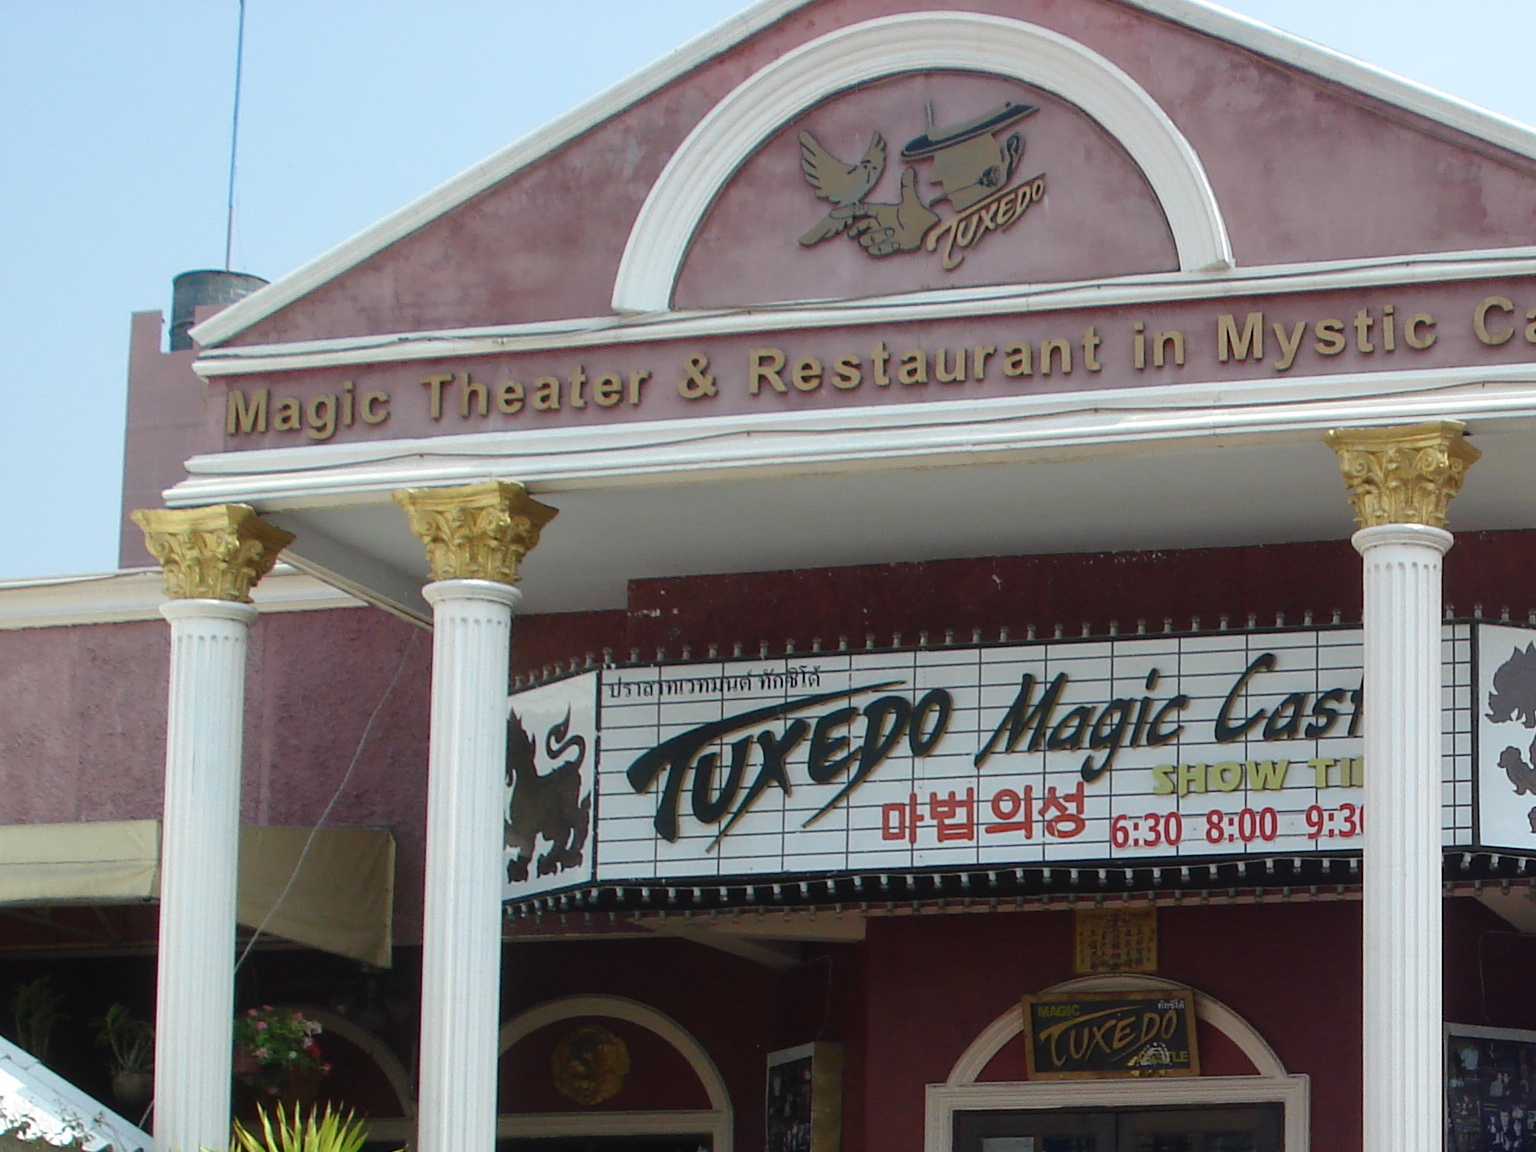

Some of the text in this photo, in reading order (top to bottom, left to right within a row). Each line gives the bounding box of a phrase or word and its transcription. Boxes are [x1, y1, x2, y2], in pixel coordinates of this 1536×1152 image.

[925, 172, 1046, 272] TUXEDO
[226, 380, 391, 440] Magic
[421, 363, 652, 420] Theater
[678, 353, 719, 400] &
[748, 326, 1103, 395] Restaurant
[1133, 321, 1185, 370] in
[1216, 304, 1437, 372] Mystic
[974, 667, 1191, 783] Magic
[626, 680, 955, 854] TUXEDO
[1152, 755, 1364, 799] SHOW TI
[1110, 810, 1183, 849] 6:30
[1204, 806, 1279, 845] 8:00
[1038, 1004, 1081, 1018] MAGIC
[1039, 1005, 1178, 1066] TUXEDO
